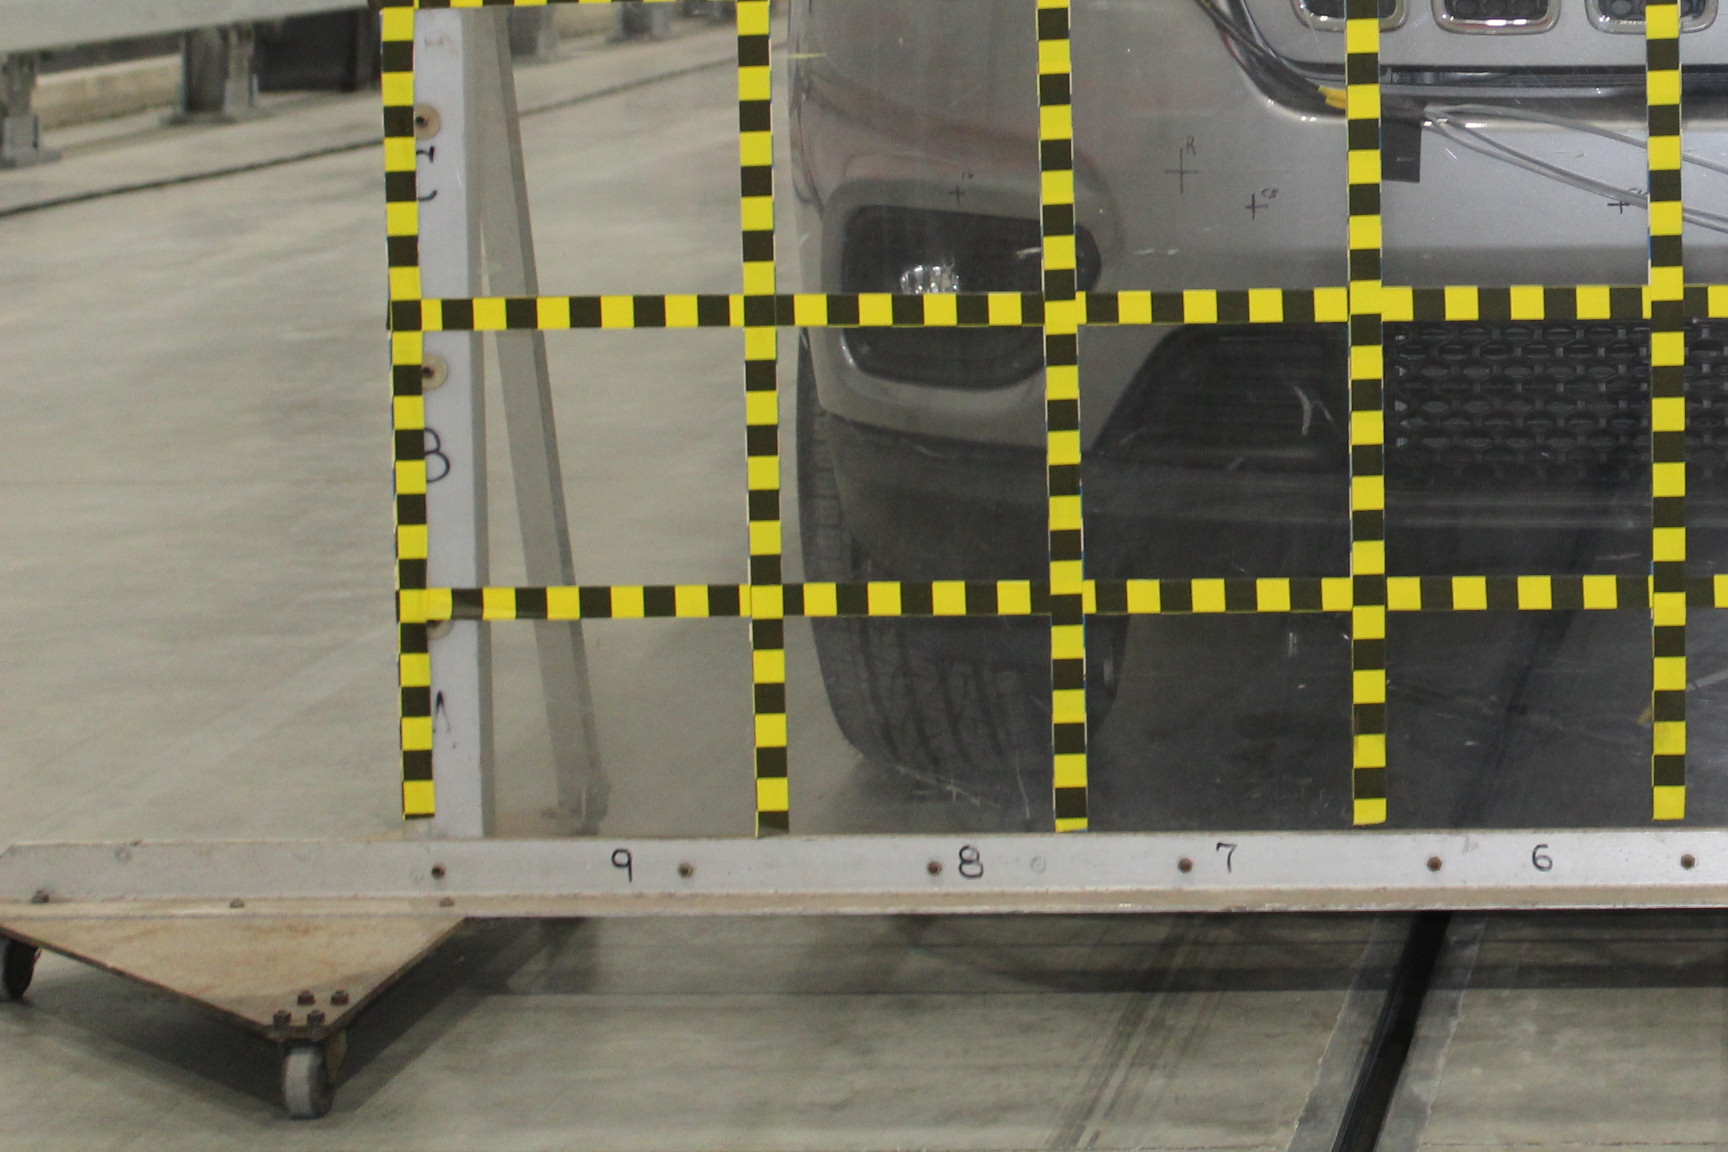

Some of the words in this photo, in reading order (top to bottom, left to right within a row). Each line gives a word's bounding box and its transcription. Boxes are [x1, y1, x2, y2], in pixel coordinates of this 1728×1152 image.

[610, 848, 633, 883] 9
[957, 844, 985, 880] 8
[1215, 841, 1238, 874] 7
[1531, 843, 1553, 873] 6
